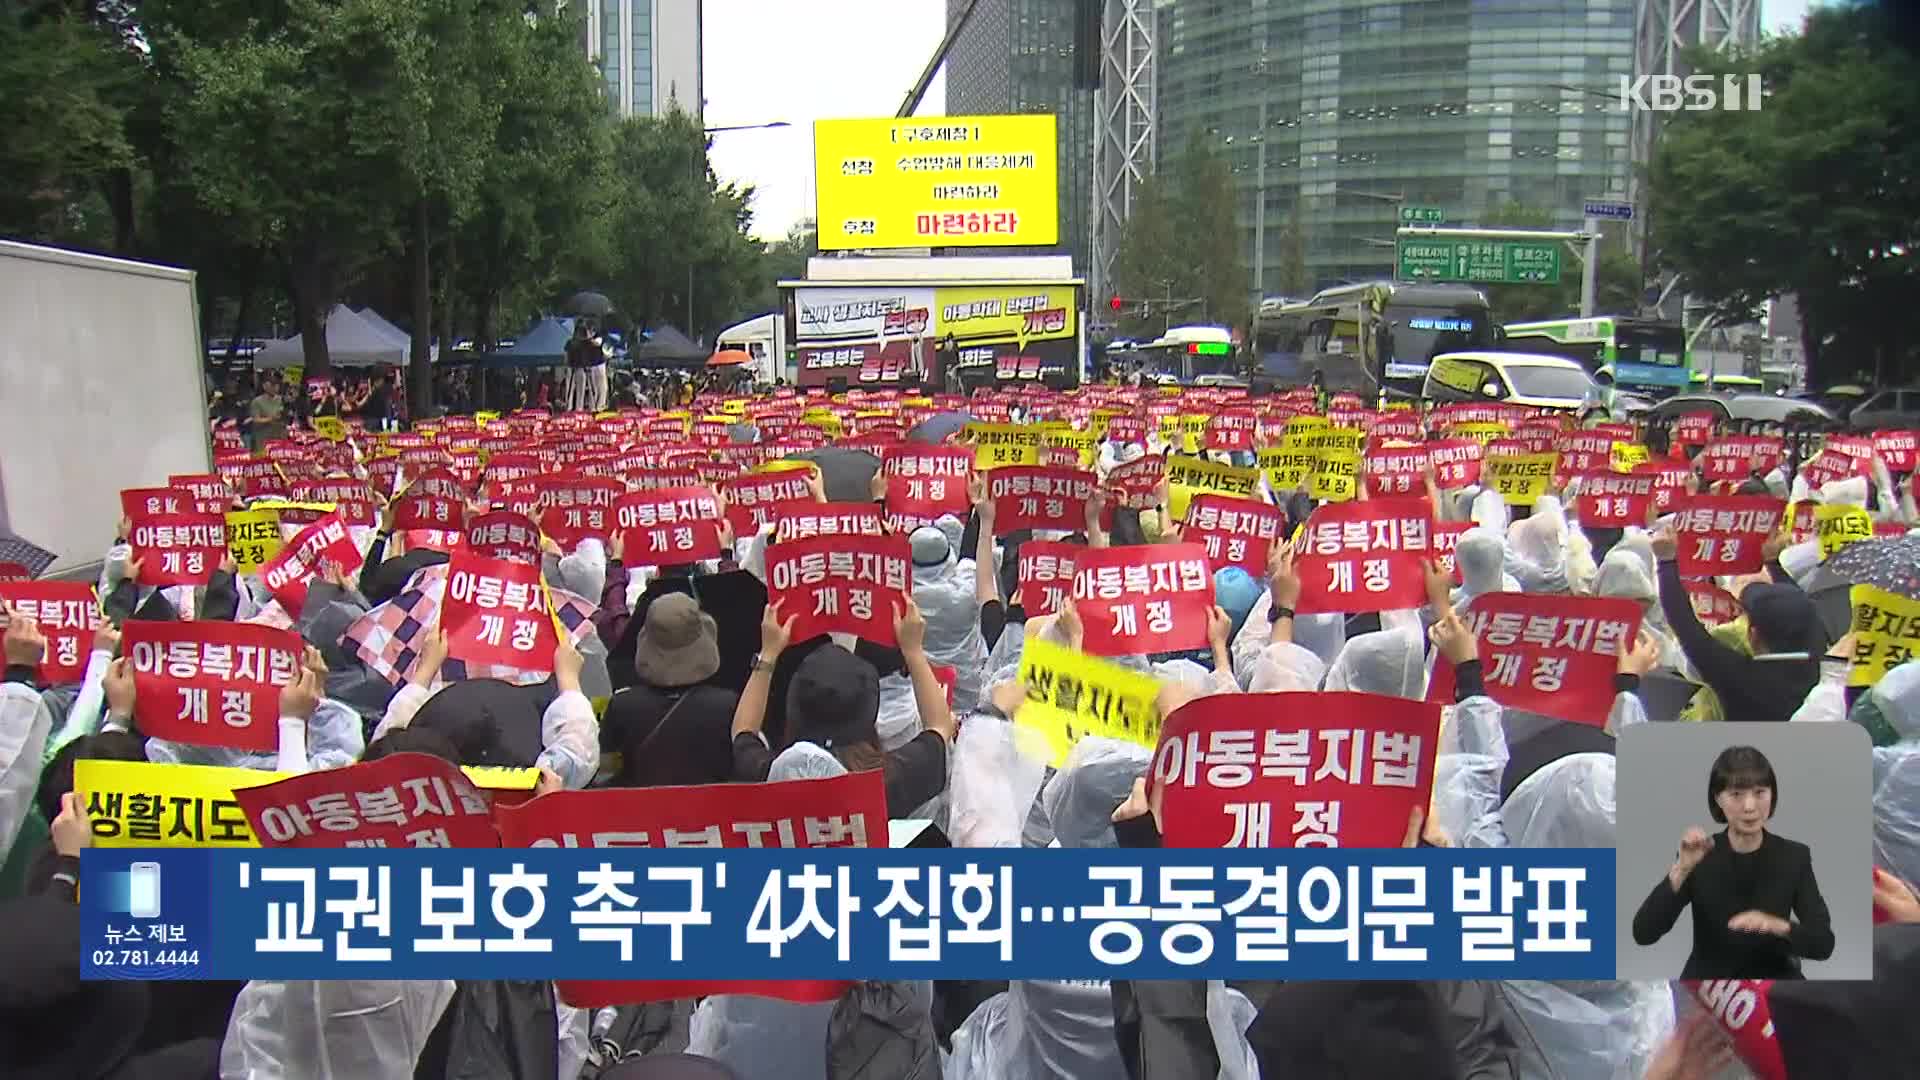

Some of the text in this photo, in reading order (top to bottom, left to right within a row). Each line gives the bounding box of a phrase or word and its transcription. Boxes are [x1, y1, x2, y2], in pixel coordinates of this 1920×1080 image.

[903, 127, 967, 143] 구호제창
[897, 157, 962, 172] 수업방해
[933, 185, 998, 200] 마련하라
[917, 212, 1018, 236] 마련하라
[885, 454, 970, 477] 아동복지법
[992, 447, 1024, 463] 보장
[905, 478, 946, 501] 개정
[991, 476, 1094, 500] 아동복지법
[565, 508, 603, 529] 개정
[618, 497, 718, 529] 아동복지법
[1017, 499, 1064, 518] 개정
[1594, 499, 1628, 517] 개정
[135, 525, 225, 549] 아동복지법
[648, 526, 694, 553] 개정
[1201, 536, 1247, 563] 개정
[1692, 536, 1742, 563] 개정
[161, 551, 205, 575] 개정
[771, 550, 908, 593] 아동복지법
[1326, 558, 1391, 594] 개정
[450, 570, 549, 615] 아동복지
[1072, 558, 1208, 600] 아동복지법
[811, 587, 874, 620] 개정
[475, 614, 539, 651] 개정
[1110, 601, 1173, 637] 개정
[132, 640, 296, 687] 아동복지법
[1484, 651, 1568, 693] 개정
[177, 685, 252, 729] 개정
[1154, 728, 1422, 788] 아동복지법
[86, 791, 251, 843] 생활지도
